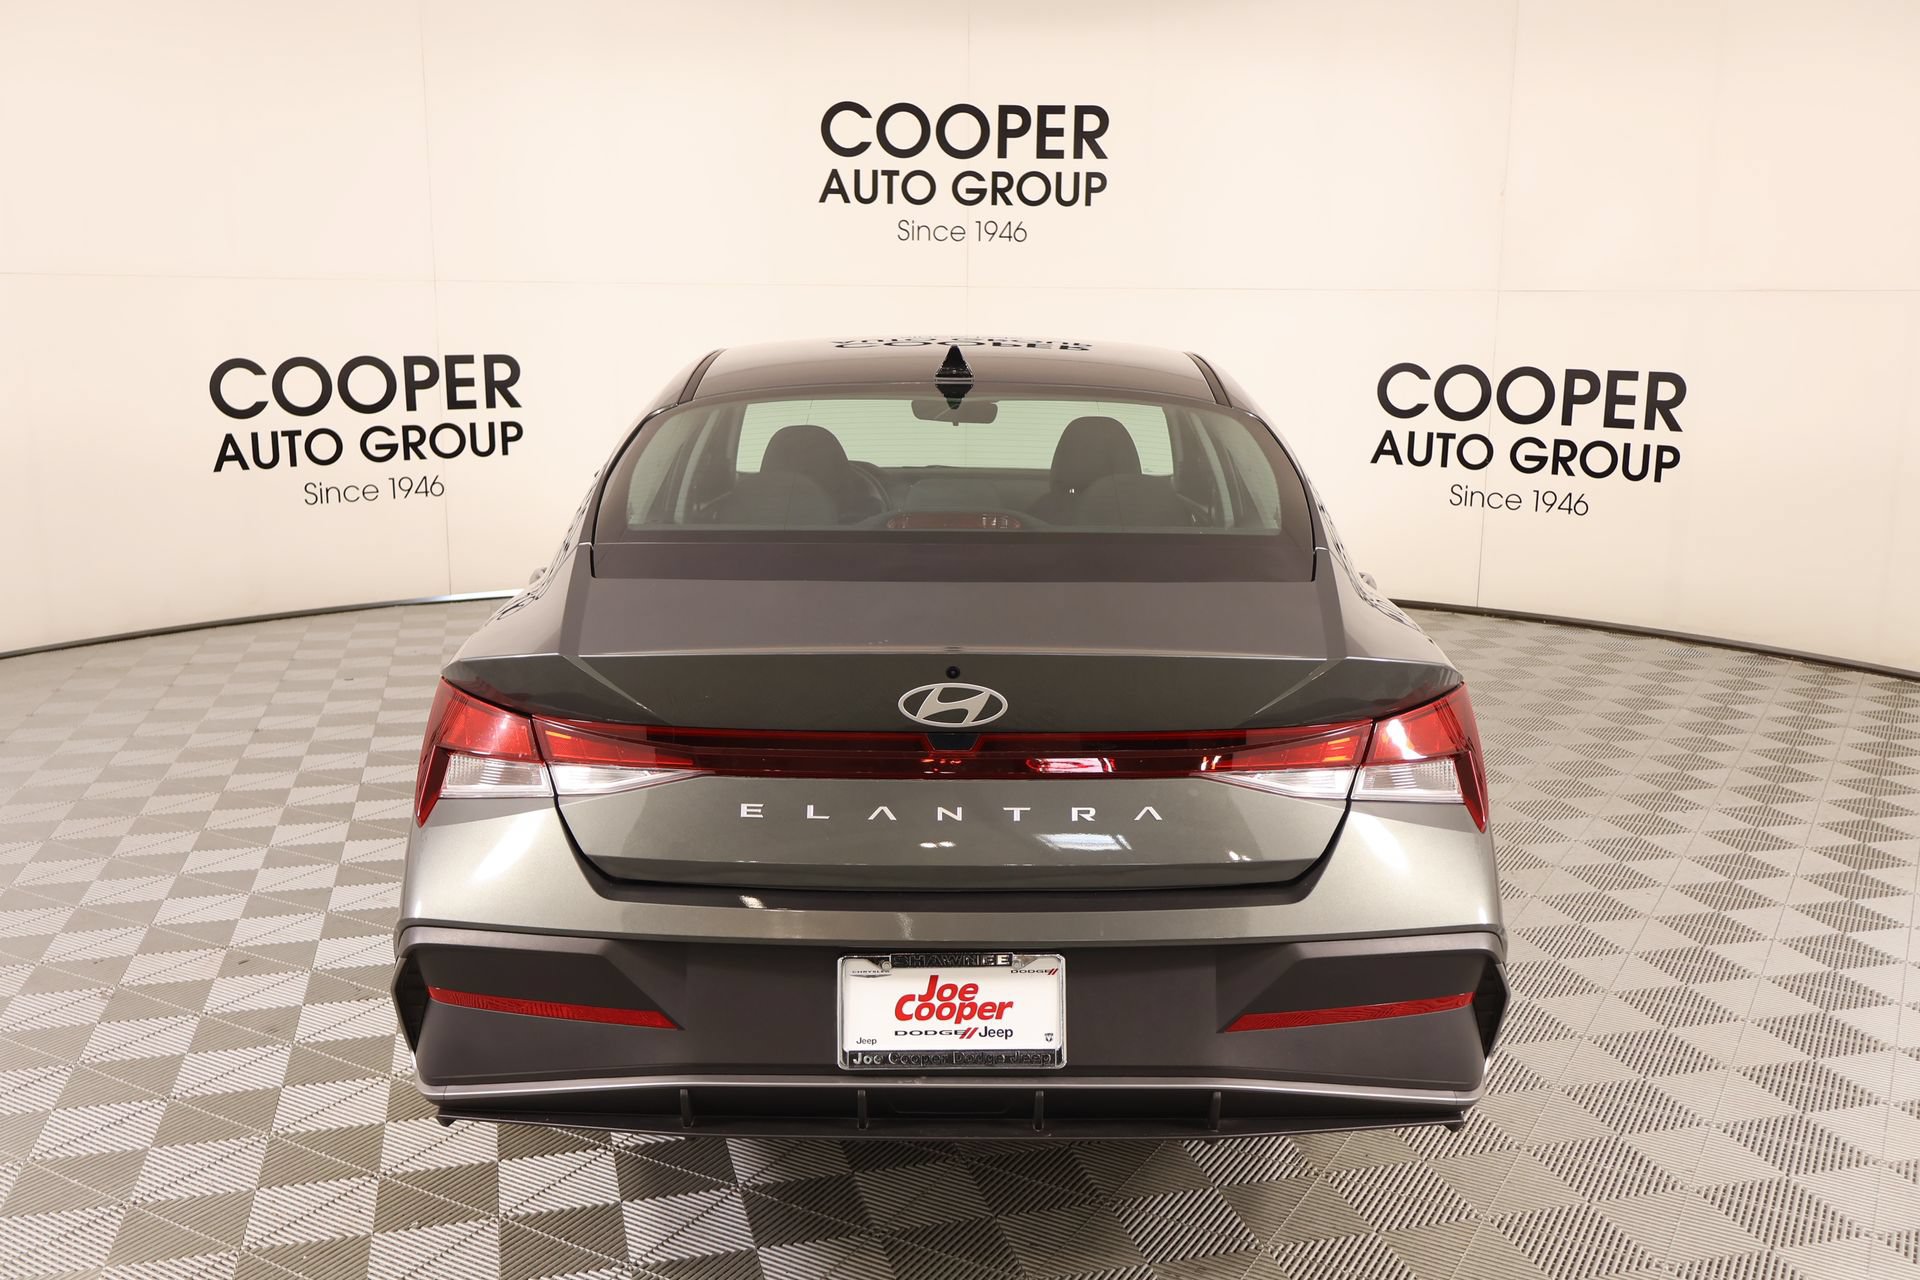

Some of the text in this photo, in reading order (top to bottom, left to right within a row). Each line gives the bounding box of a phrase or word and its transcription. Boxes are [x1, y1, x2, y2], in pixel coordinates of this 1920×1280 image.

[821, 101, 1109, 160] COOPER
[819, 168, 1107, 207] AUTO GROUP
[897, 219, 1027, 243] Since 1946
[210, 354, 522, 419] COOPER
[1377, 362, 1687, 432] COOPER
[213, 421, 524, 472] AUTO GROUP
[1370, 430, 1681, 483] AUTO GROUP
[304, 475, 445, 505] Since 1946
[1449, 484, 1589, 516] Since 1946
[740, 803, 1162, 822] ELANTRA
[894, 955, 1009, 966] SHAWNEE
[918, 975, 978, 1001] Joe
[895, 994, 1013, 1024] Cooper
[856, 1037, 877, 1045] Jeep
[979, 1026, 1013, 1040] Jeep
[853, 1051, 1051, 1066] Joe Cooper Dodge Jeep
